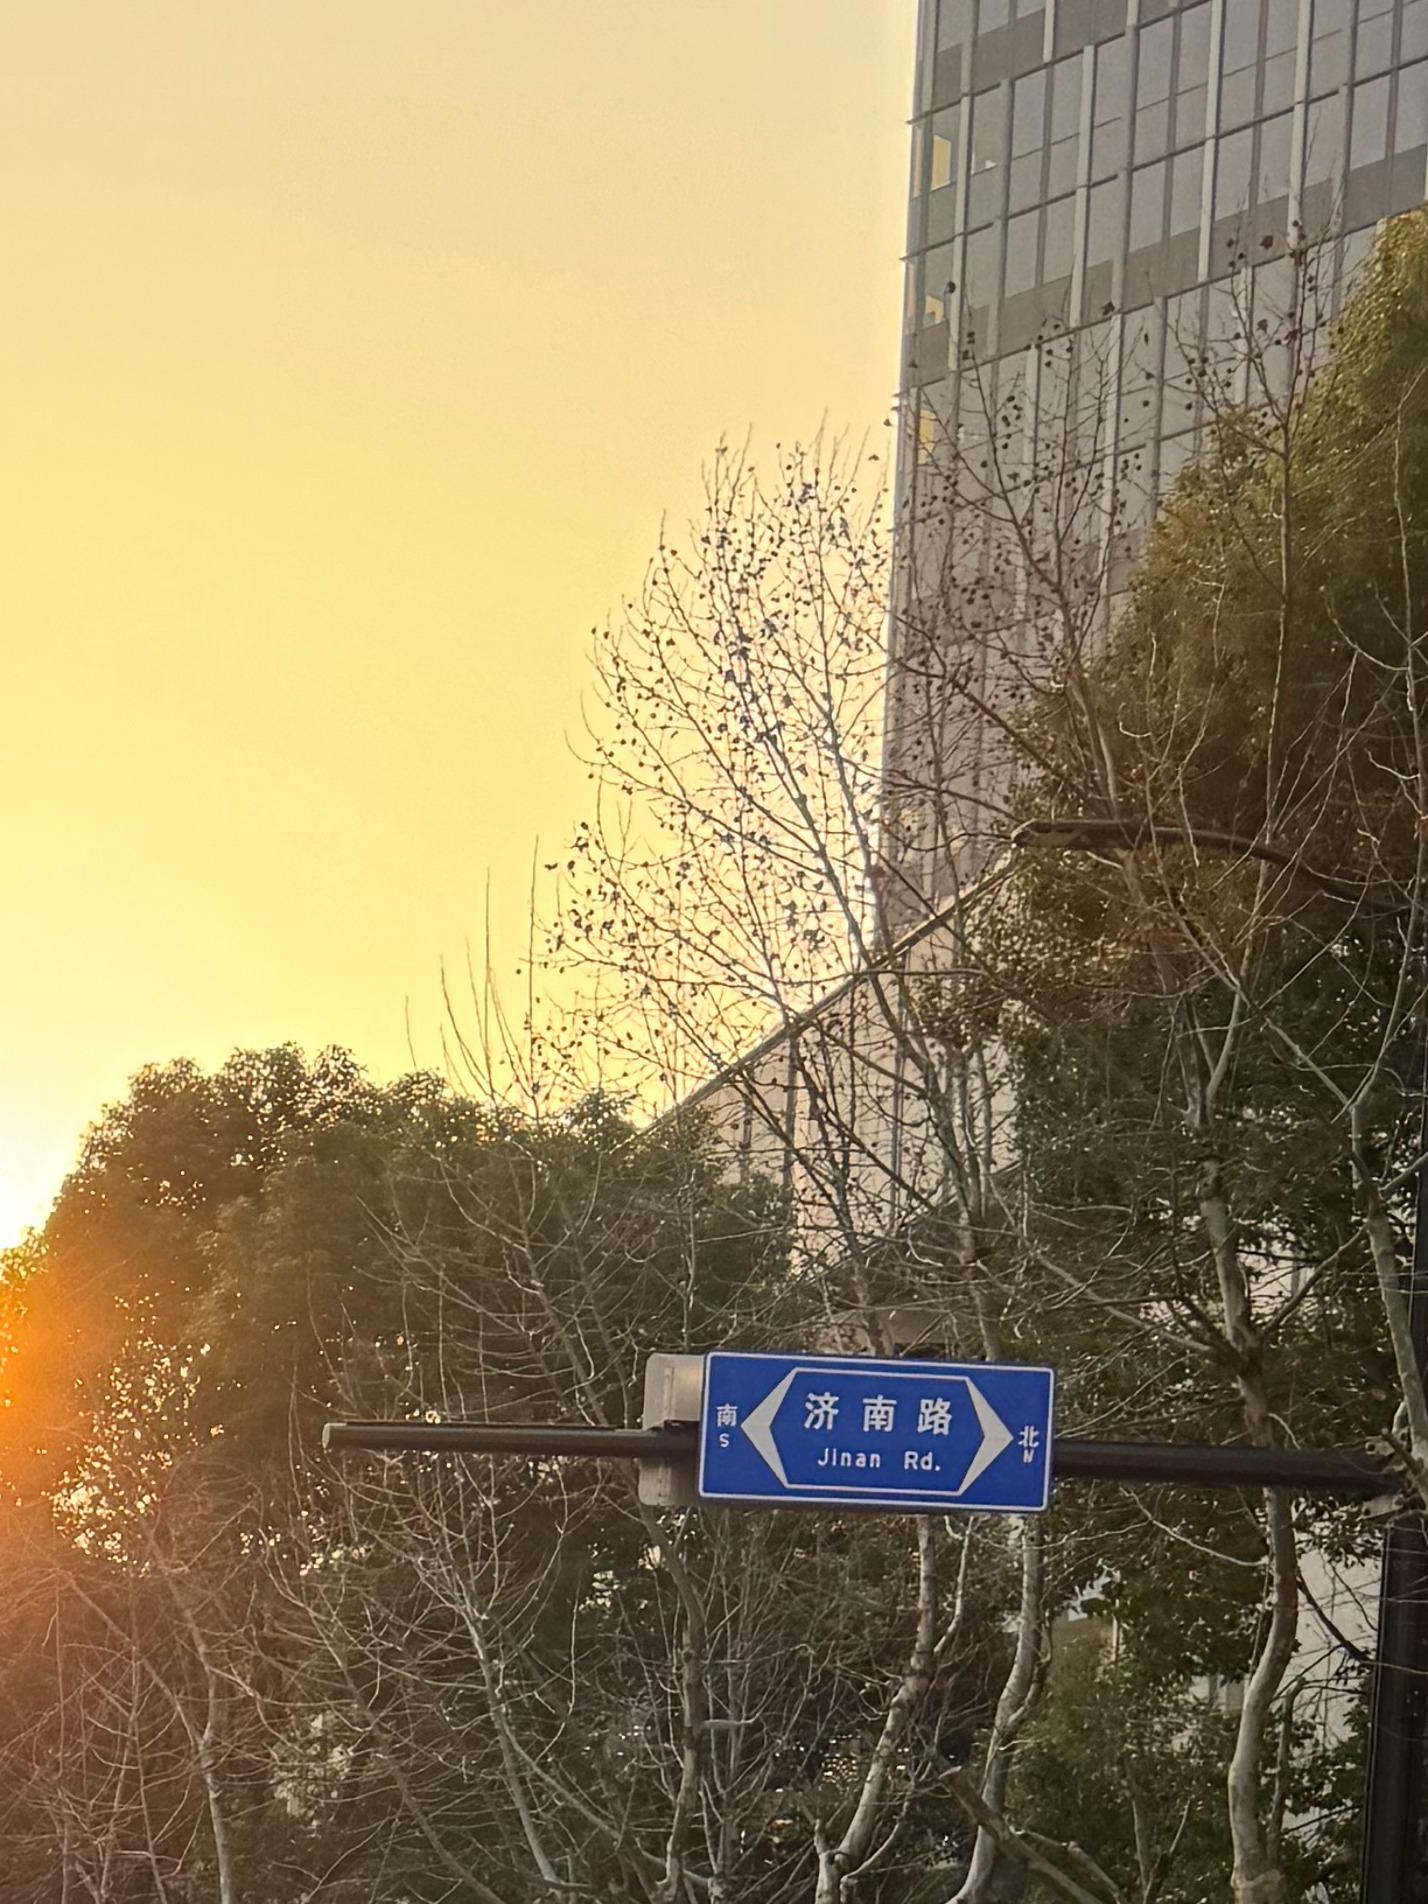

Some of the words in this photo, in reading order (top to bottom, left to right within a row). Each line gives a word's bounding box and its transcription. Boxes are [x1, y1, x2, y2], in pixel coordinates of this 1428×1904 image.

[716, 1403, 738, 1428] 南
[802, 1391, 953, 1436] 济南路
[719, 1434, 730, 1448] S
[1018, 1426, 1039, 1448] 北
[818, 1448, 881, 1469] Jinan
[904, 1452, 941, 1472] Rd.
